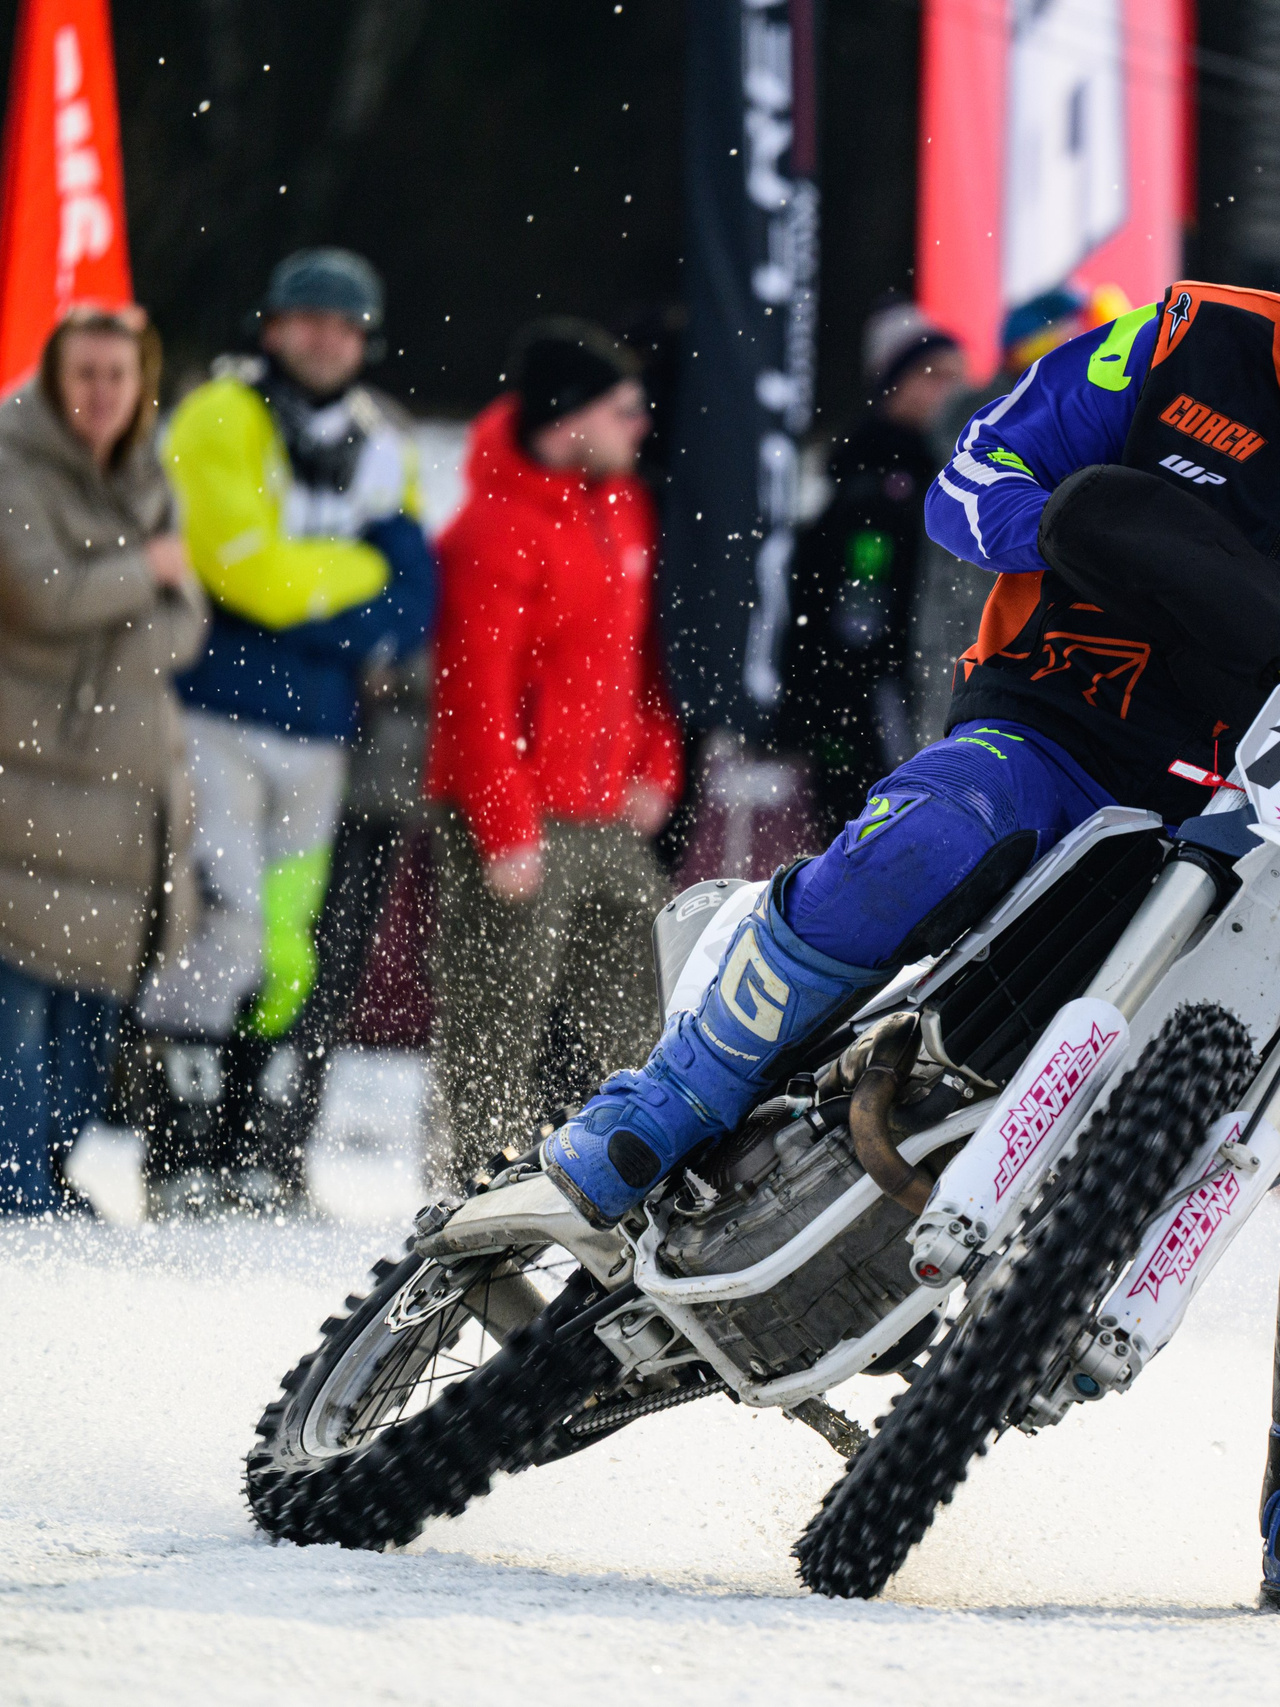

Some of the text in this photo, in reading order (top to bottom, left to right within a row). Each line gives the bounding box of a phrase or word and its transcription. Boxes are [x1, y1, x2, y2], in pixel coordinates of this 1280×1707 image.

[1158, 392, 1269, 463] COACH
[1158, 454, 1227, 485] WP
[720, 928, 790, 1042] G
[999, 1041, 1077, 1148] RACING
[1126, 1121, 1243, 1303] TECHNO
[1168, 1171, 1241, 1286] RACING
